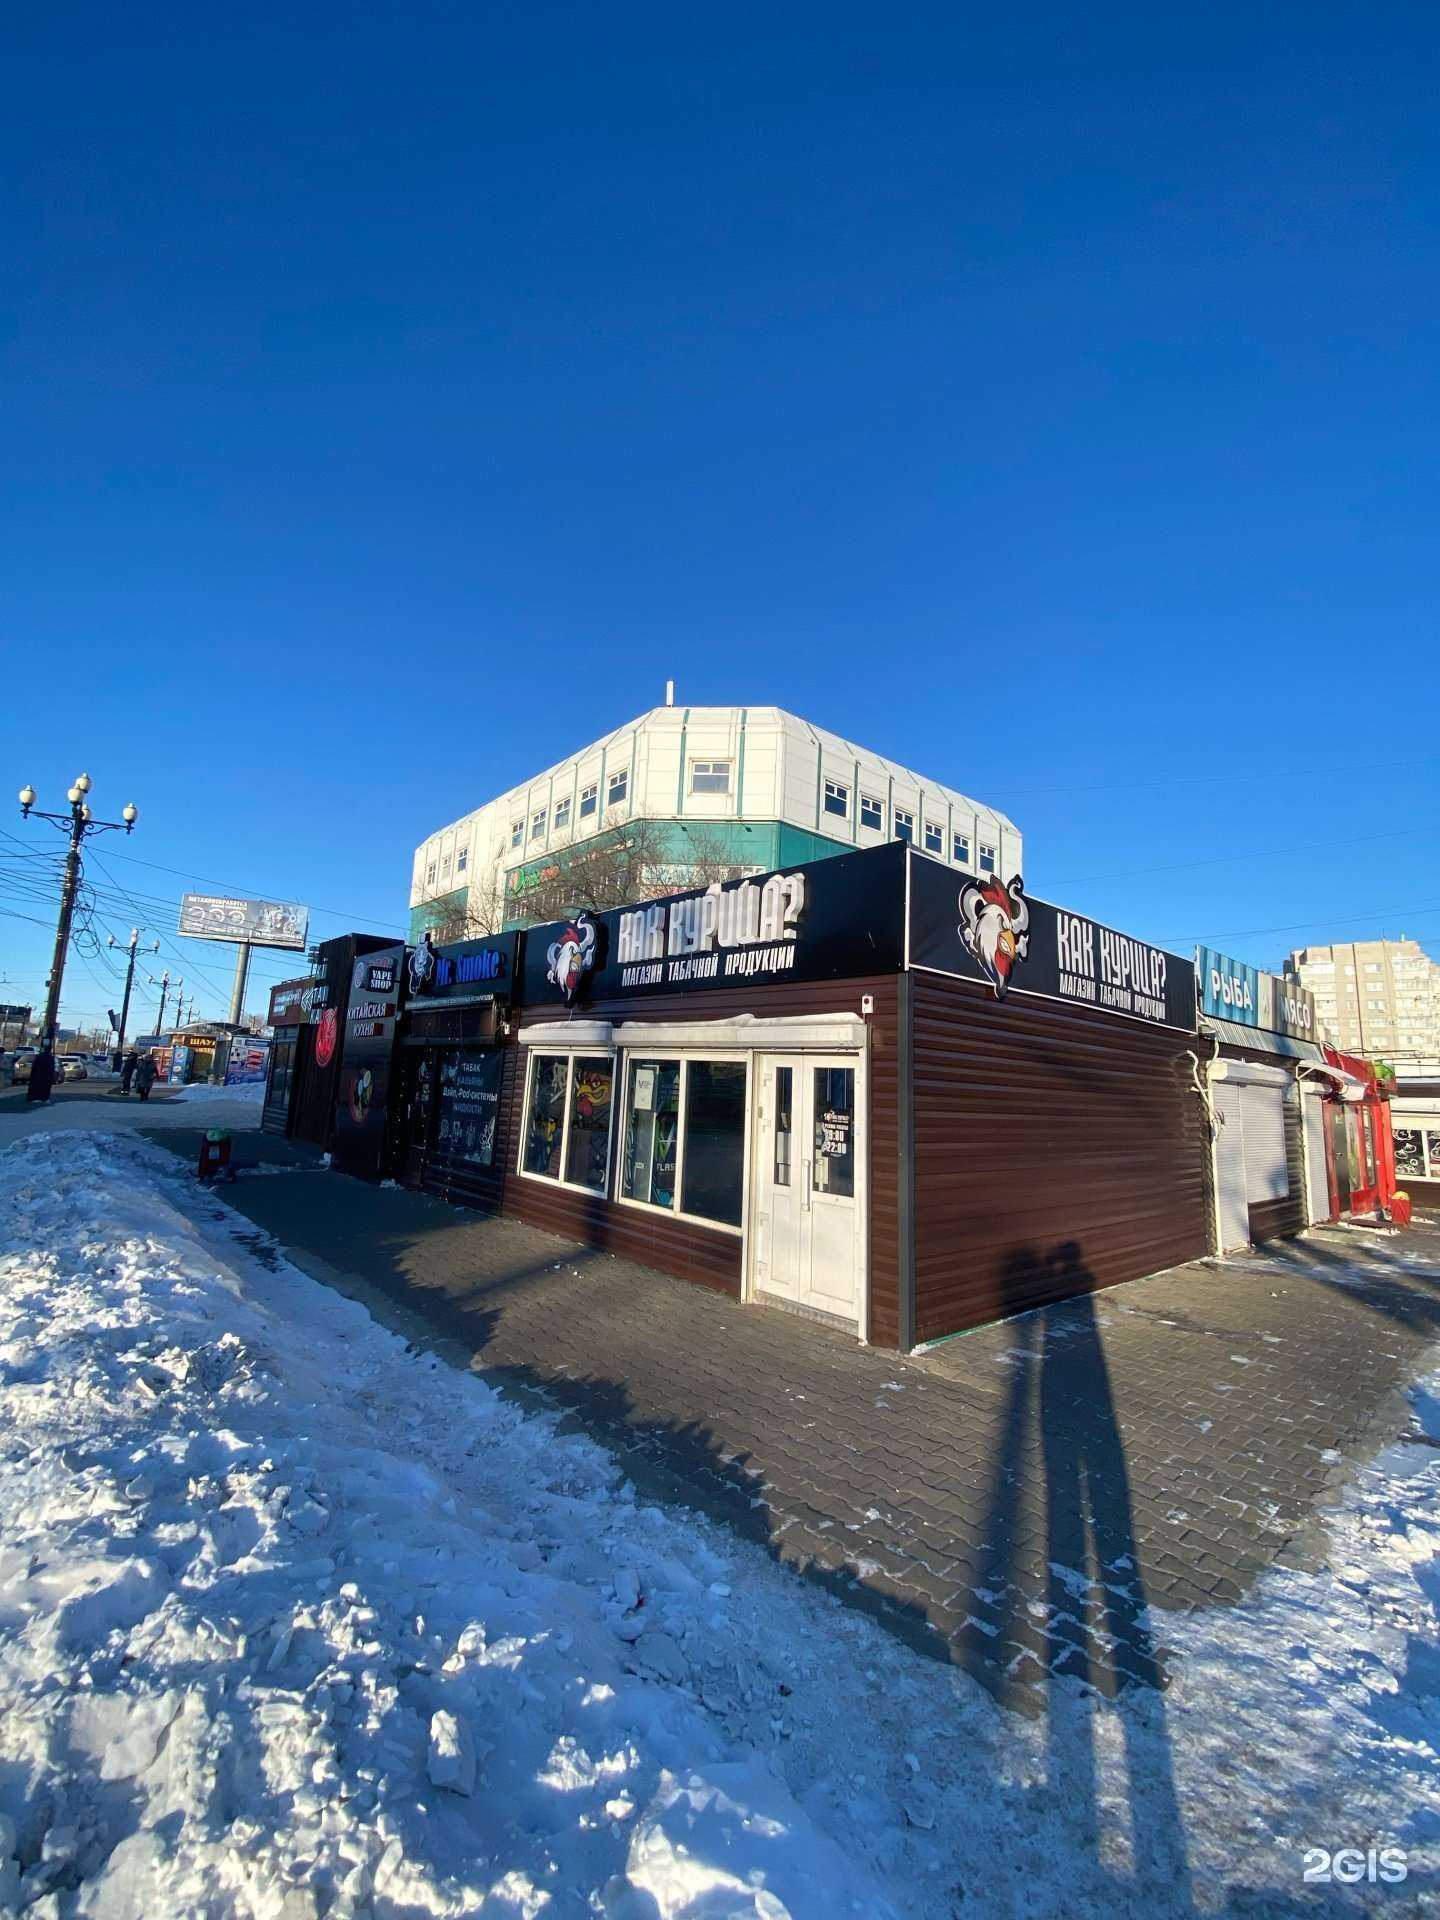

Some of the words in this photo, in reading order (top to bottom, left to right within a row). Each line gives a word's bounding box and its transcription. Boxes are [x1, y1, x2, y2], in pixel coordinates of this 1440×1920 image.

[618, 903, 666, 963] КАК
[668, 873, 806, 956] КУРИЦА?
[621, 963, 664, 987] МАГАЗИН
[668, 952, 719, 981] ТАБАЧНОЙ
[724, 945, 796, 976] ПРОДУКЦИИ
[1057, 911, 1095, 979] КАК
[1100, 928, 1167, 1000] КУРИЦА?
[370, 979, 392, 990] SHOP
[372, 970, 393, 981] VAPE
[1060, 973, 1096, 1001] МАГАЗИН
[1100, 983, 1132, 1011] ТАБАЧНОЙ
[1211, 968, 1253, 1011] РЫБА
[347, 1001, 387, 1020] КИТАЙСКАЯ
[1281, 993, 1312, 1030] МЯСО
[353, 1022, 375, 1037] КУХНЯ
[462, 1063, 481, 1073] ТАБАК
